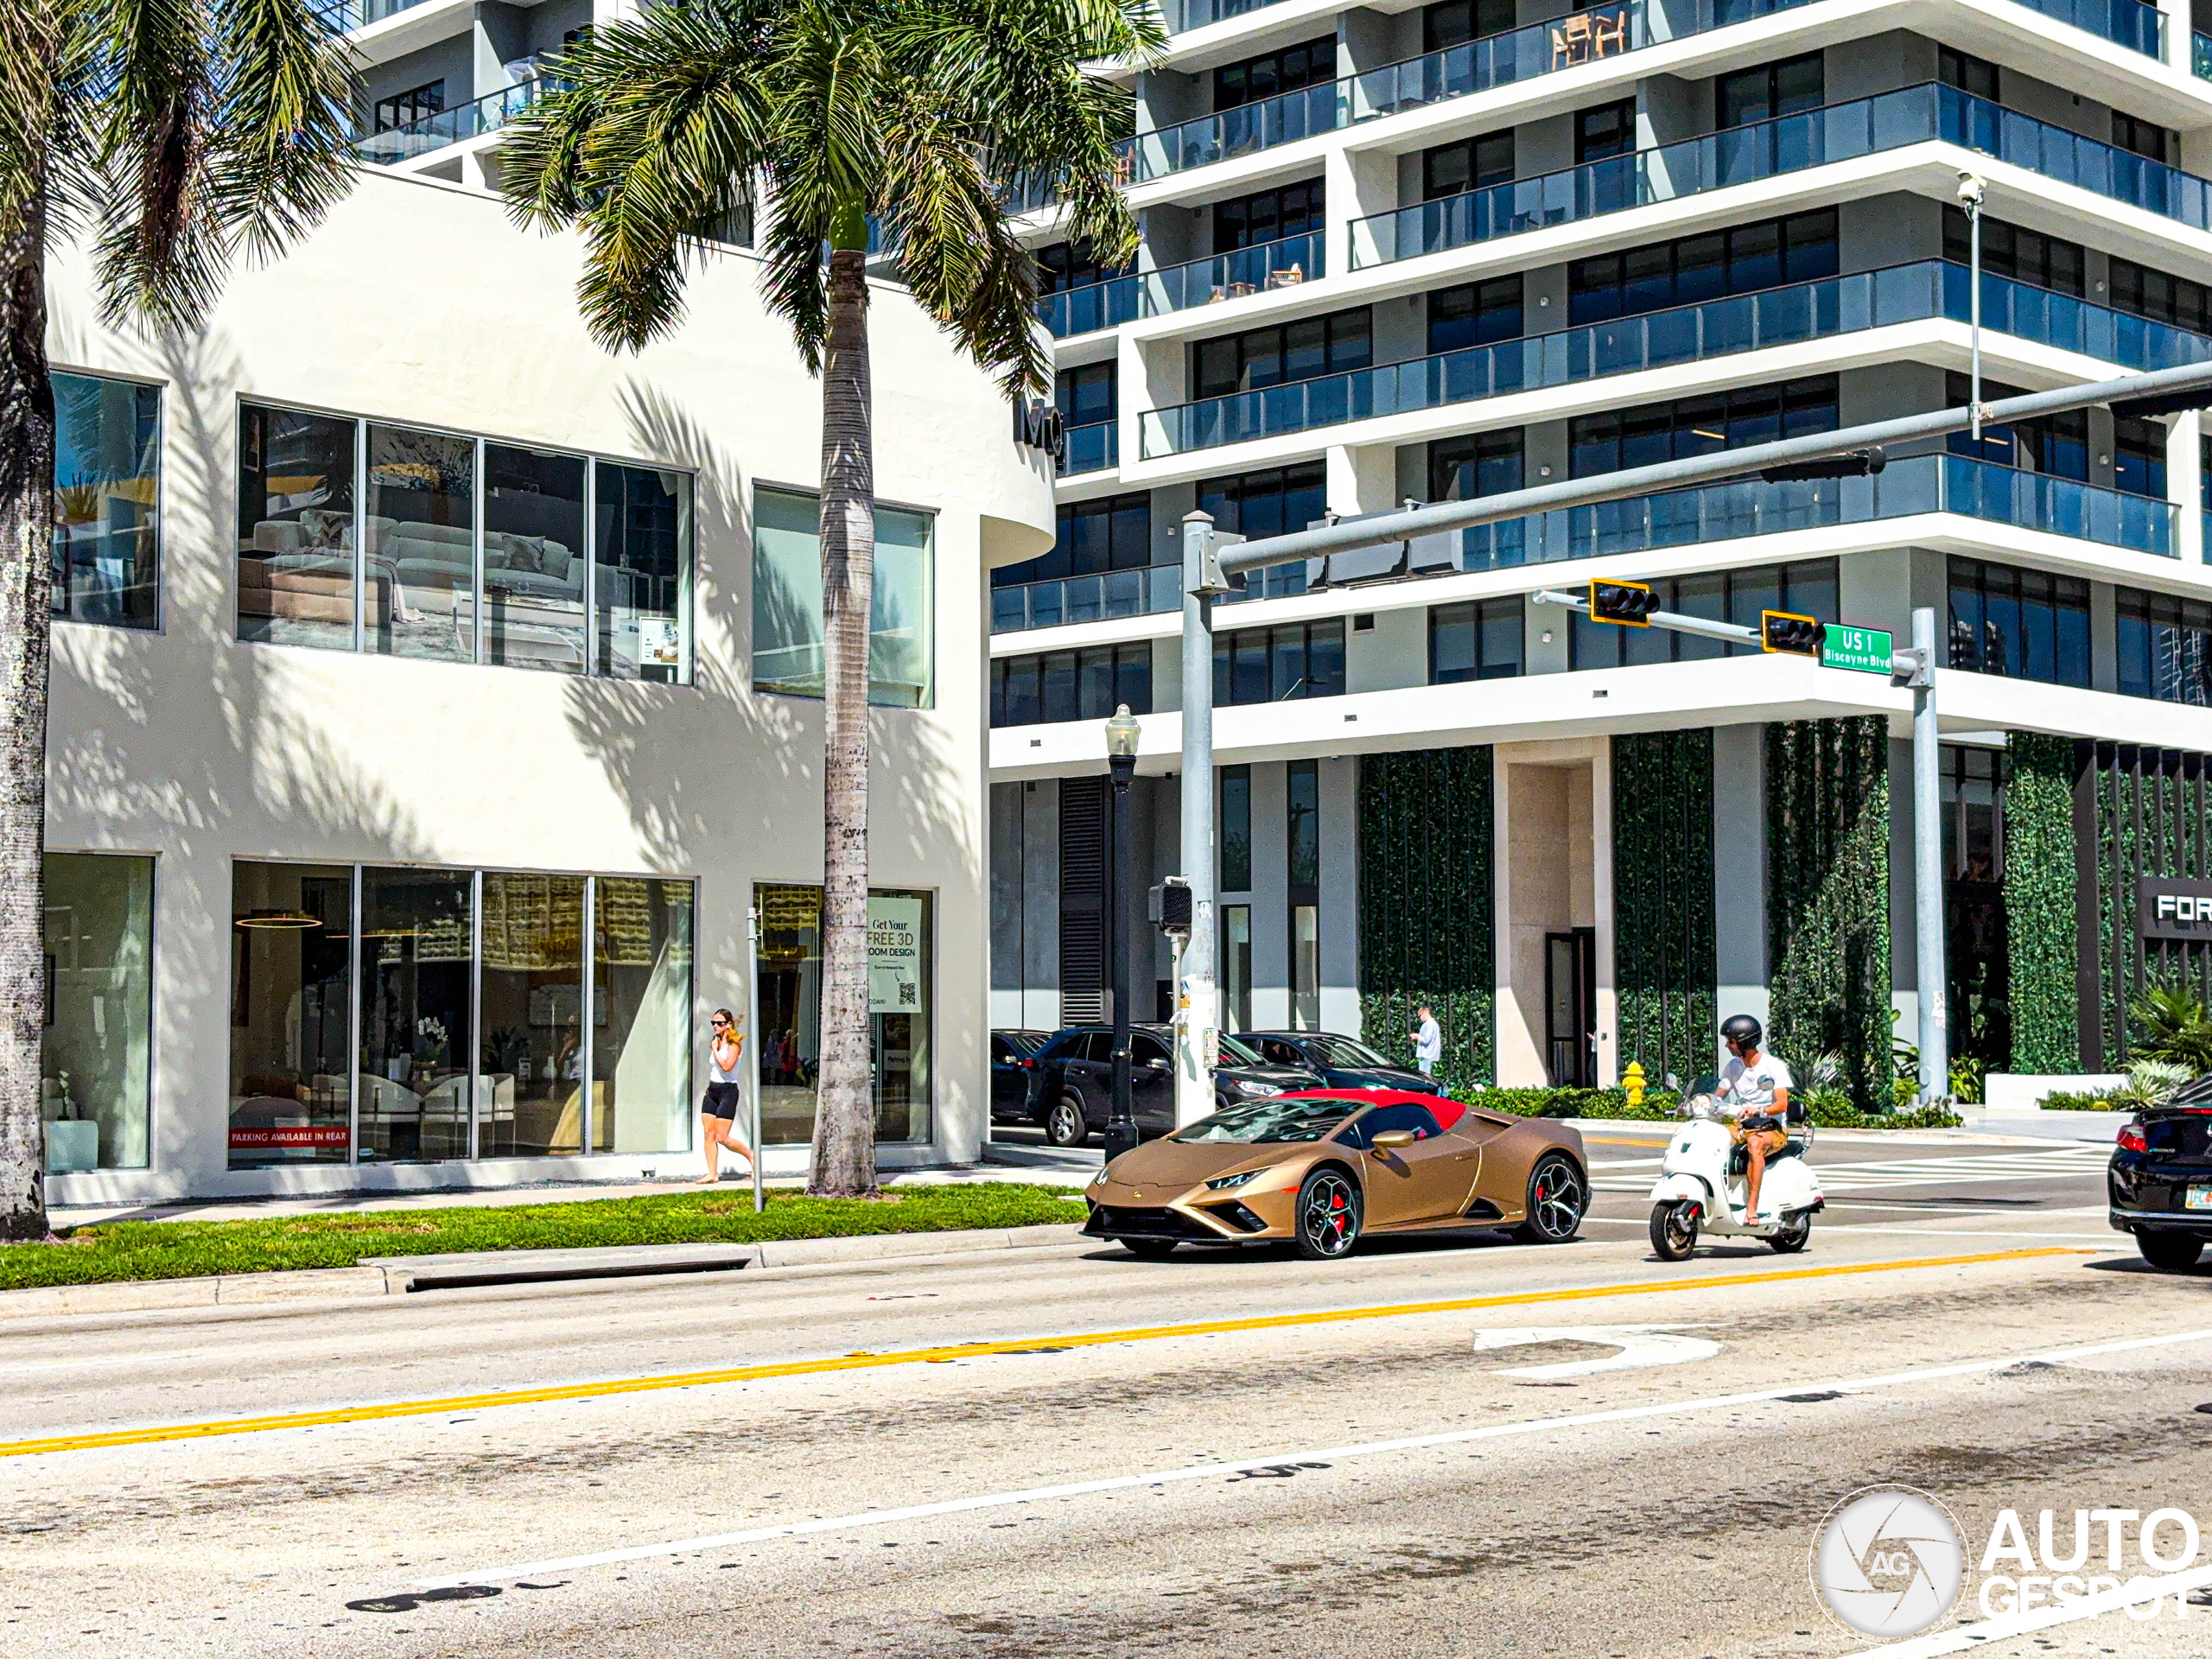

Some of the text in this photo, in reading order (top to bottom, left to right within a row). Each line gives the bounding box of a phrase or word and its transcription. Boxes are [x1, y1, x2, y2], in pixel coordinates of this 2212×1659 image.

[1843, 630, 1872, 652] US 1
[1825, 648, 1891, 669] Biscayne Blvd
[873, 919, 908, 931] Get Your
[868, 931, 913, 946] FREE 3D
[868, 947, 915, 957] OOM DESIGN
[232, 1132, 346, 1141] PARKING AVAILABLE IN REAR
